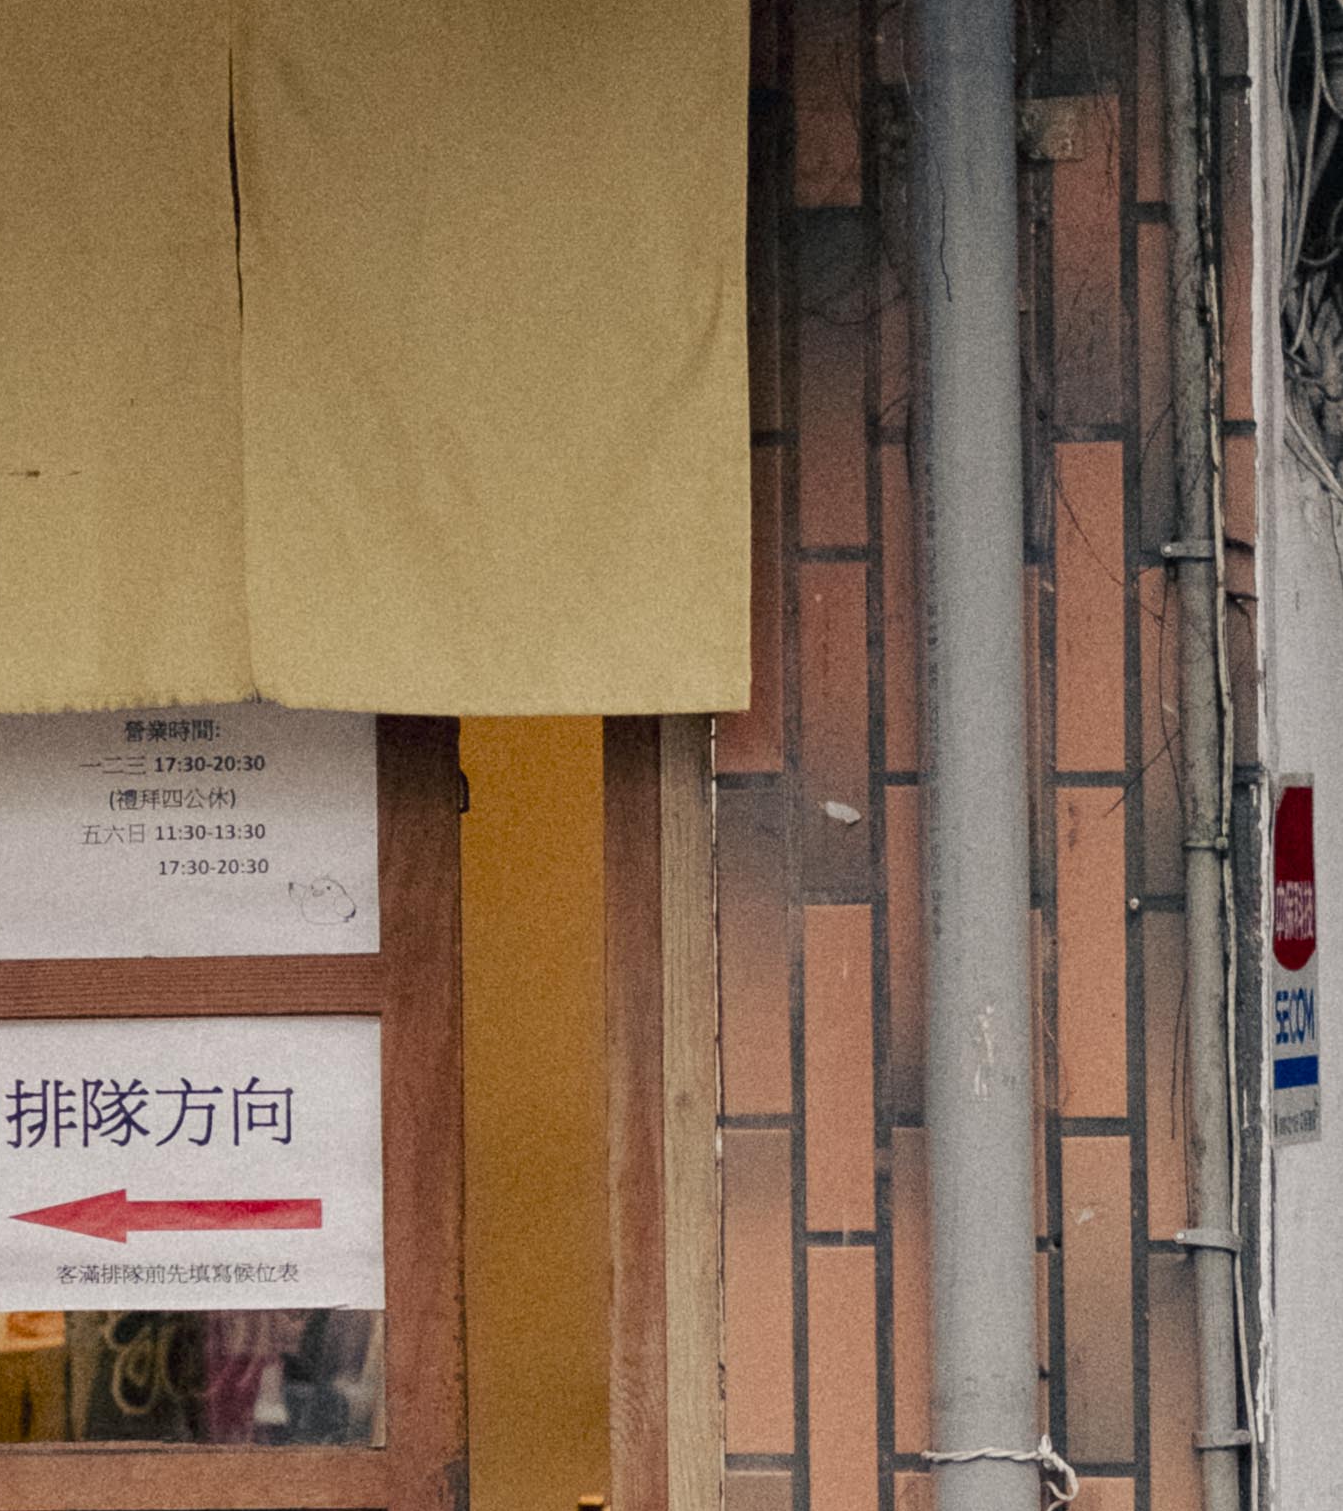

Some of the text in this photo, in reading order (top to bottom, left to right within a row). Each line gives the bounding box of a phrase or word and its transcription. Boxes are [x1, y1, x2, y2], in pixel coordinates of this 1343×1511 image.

[124, 719, 221, 742] 營業時間:
[79, 755, 265, 775] 一二三 17:30-20:30
[109, 787, 237, 811] (禮拜四公休)
[81, 823, 266, 846] 五六日 11:30-13:30
[159, 858, 270, 876] 17:30-20:30
[5, 1076, 294, 1149] 排隊方向
[56, 1263, 300, 1285] 客滿排隊前先填寫候位表
